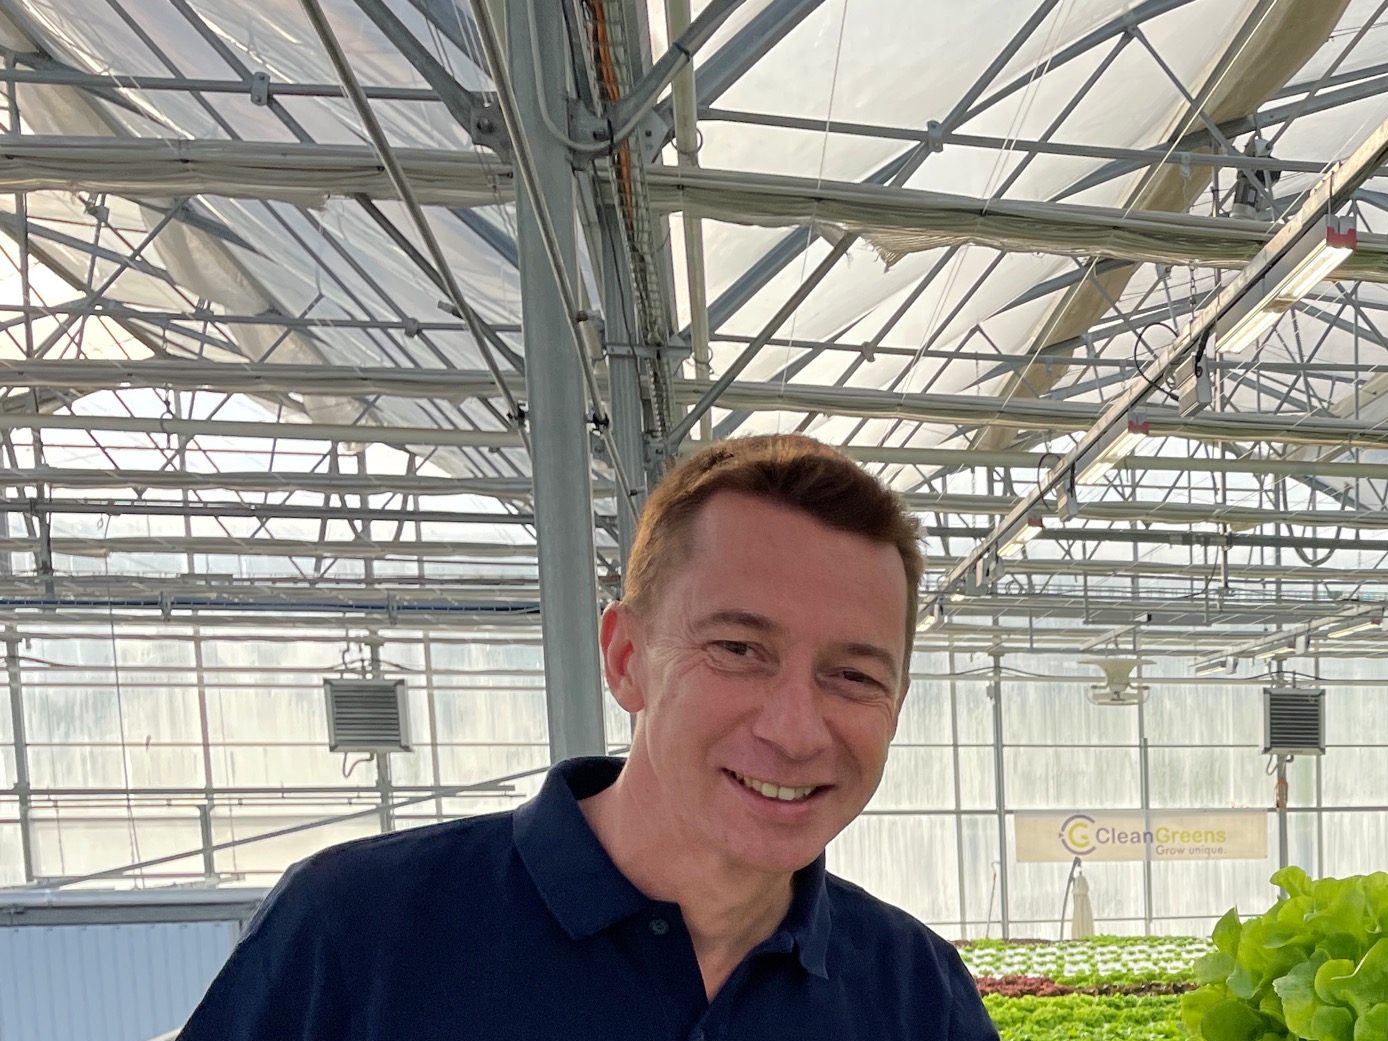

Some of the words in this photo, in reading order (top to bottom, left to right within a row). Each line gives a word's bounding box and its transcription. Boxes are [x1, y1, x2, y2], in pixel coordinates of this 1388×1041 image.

[1096, 827, 1227, 844] CleanGreens
[1156, 845, 1185, 856] Grow
[1189, 845, 1227, 857] unique.
